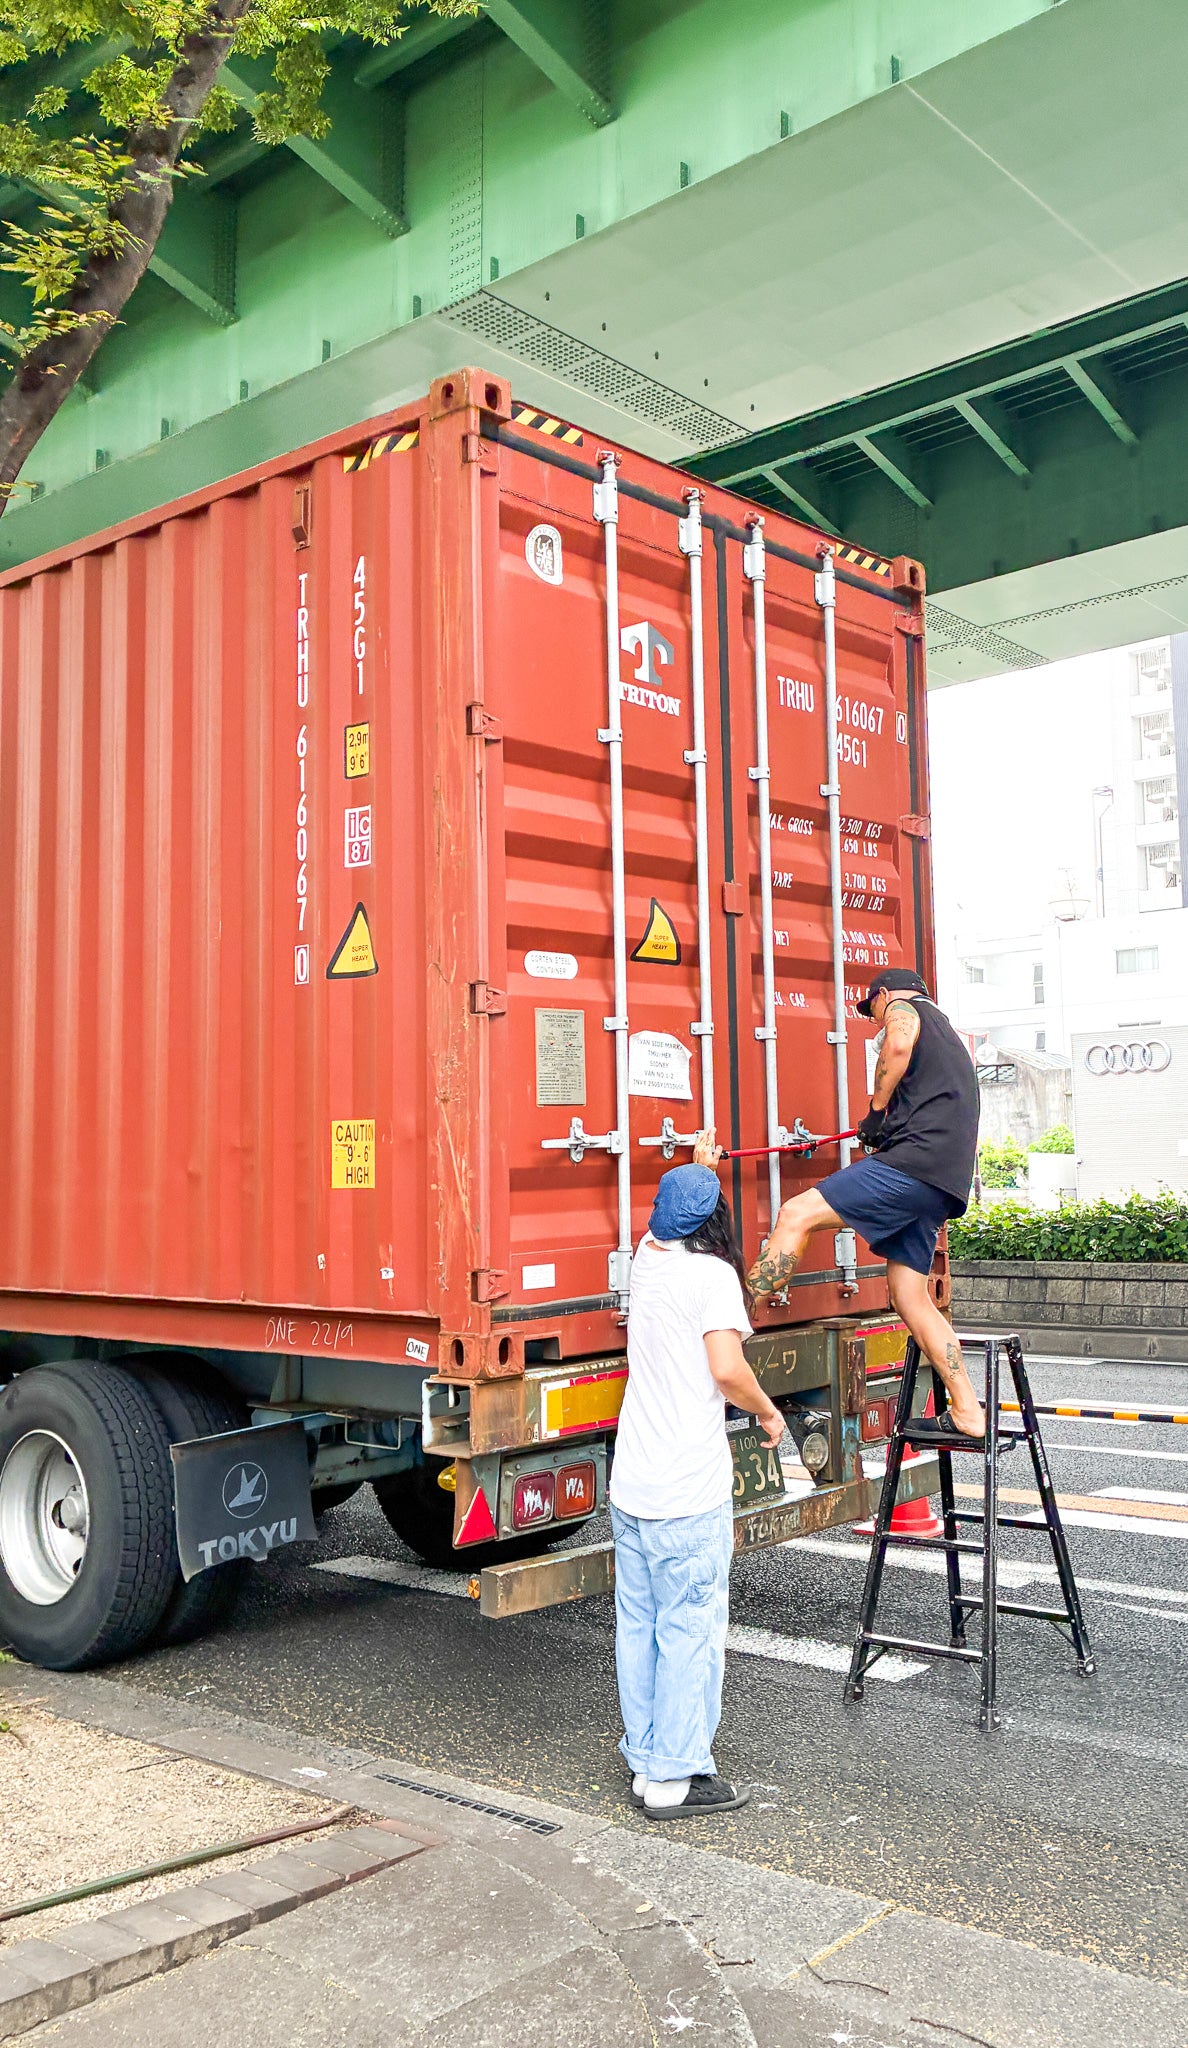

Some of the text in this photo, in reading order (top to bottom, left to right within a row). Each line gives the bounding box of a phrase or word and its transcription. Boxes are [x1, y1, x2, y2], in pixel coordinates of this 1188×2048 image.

[353, 555, 366, 696] 45G1
[619, 681, 681, 717] TRITON
[777, 675, 906, 742] TRHU 616067 0
[836, 732, 867, 769] 45G1
[297, 573, 309, 982] TRHU 616067 0
[787, 816, 814, 836] GROSS
[839, 817, 863, 835] 2.500
[864, 822, 883, 839] KGS
[350, 841, 370, 862] 87
[863, 841, 878, 858] LBS
[773, 870, 887, 893] TARE 3.700 KGS
[867, 895, 885, 911] LBS
[352, 944, 368, 953] SUPER
[868, 932, 887, 947] KGS
[352, 954, 368, 962] HEAVY
[873, 950, 889, 966] LBS
[335, 1123, 374, 1142] CAUTION
[345, 1166, 370, 1185] HIGH
[265, 1316, 297, 1348] ONE
[406, 1341, 427, 1358] ONE
[739, 1435, 758, 1452] 100
[198, 1517, 298, 1567] TOKYU
